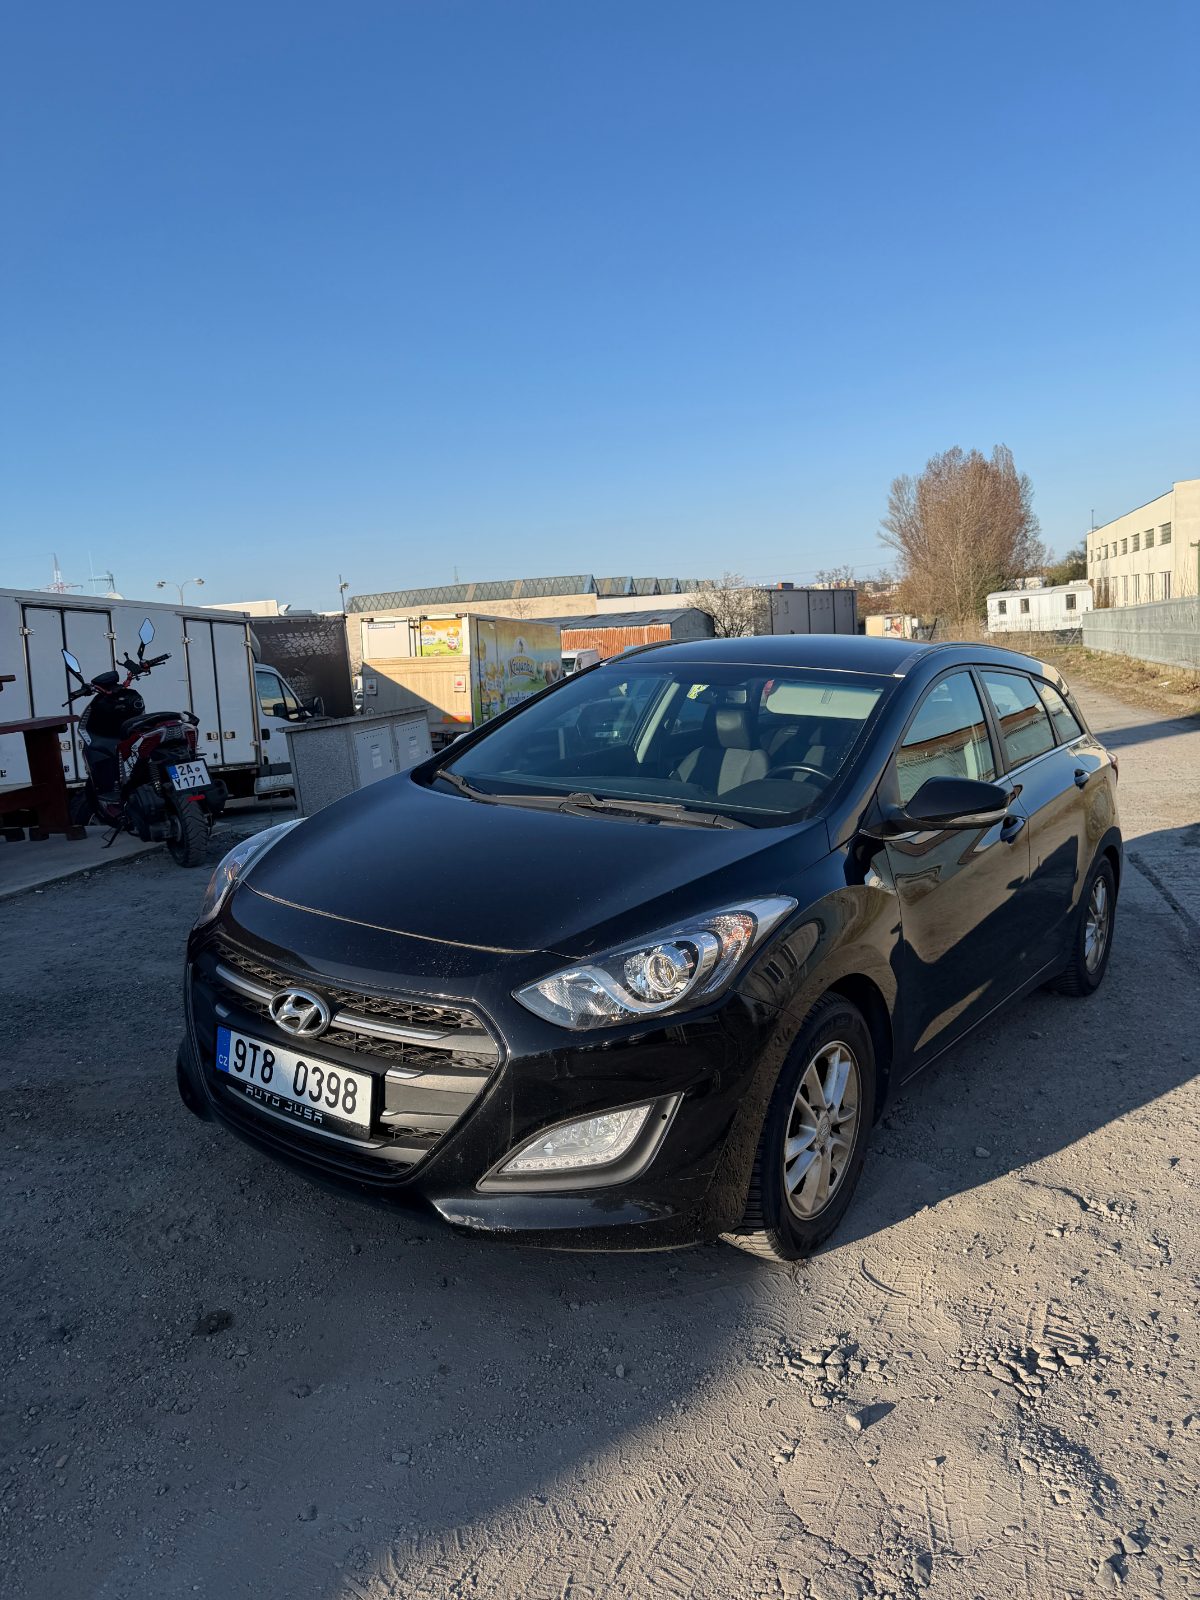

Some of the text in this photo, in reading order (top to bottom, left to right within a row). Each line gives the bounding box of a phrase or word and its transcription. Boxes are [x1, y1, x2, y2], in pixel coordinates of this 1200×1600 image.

[178, 764, 194, 776] 2A
[175, 774, 205, 789] Y171
[218, 1054, 228, 1067] CZ
[233, 1038, 358, 1115] 9T8 0398
[245, 1084, 280, 1107] AUTO
